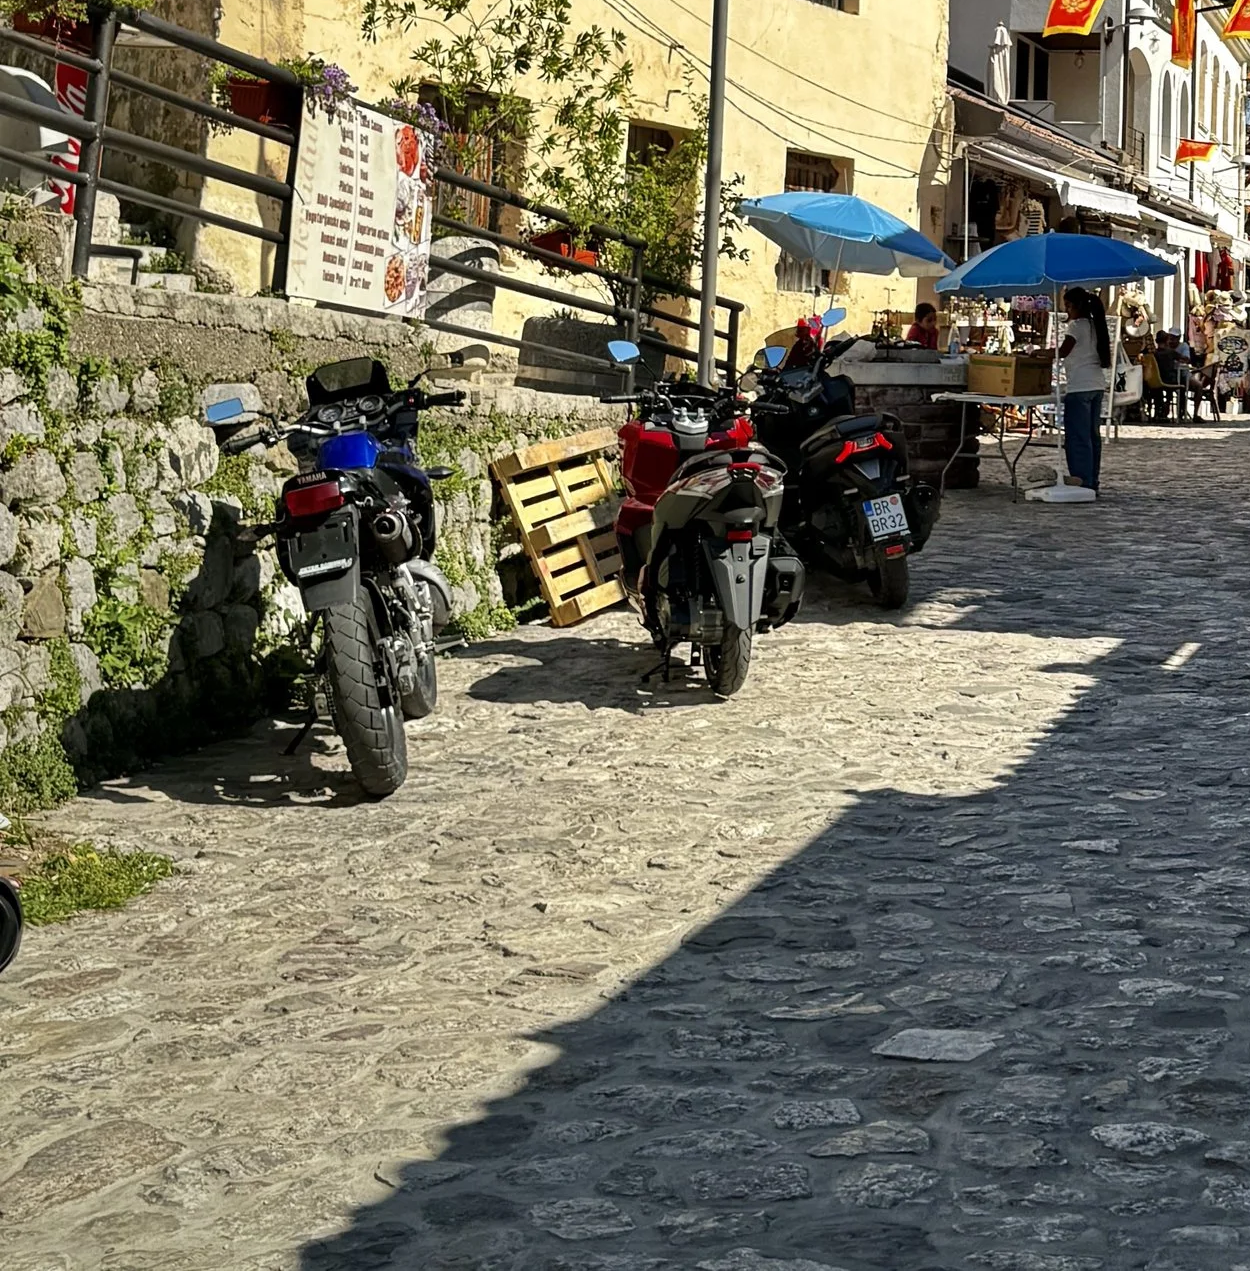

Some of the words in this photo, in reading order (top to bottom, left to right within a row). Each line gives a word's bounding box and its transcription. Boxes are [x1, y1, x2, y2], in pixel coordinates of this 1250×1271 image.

[297, 471, 327, 485] YAMAHA
[873, 500, 891, 516] BR
[871, 514, 905, 533] BR32
